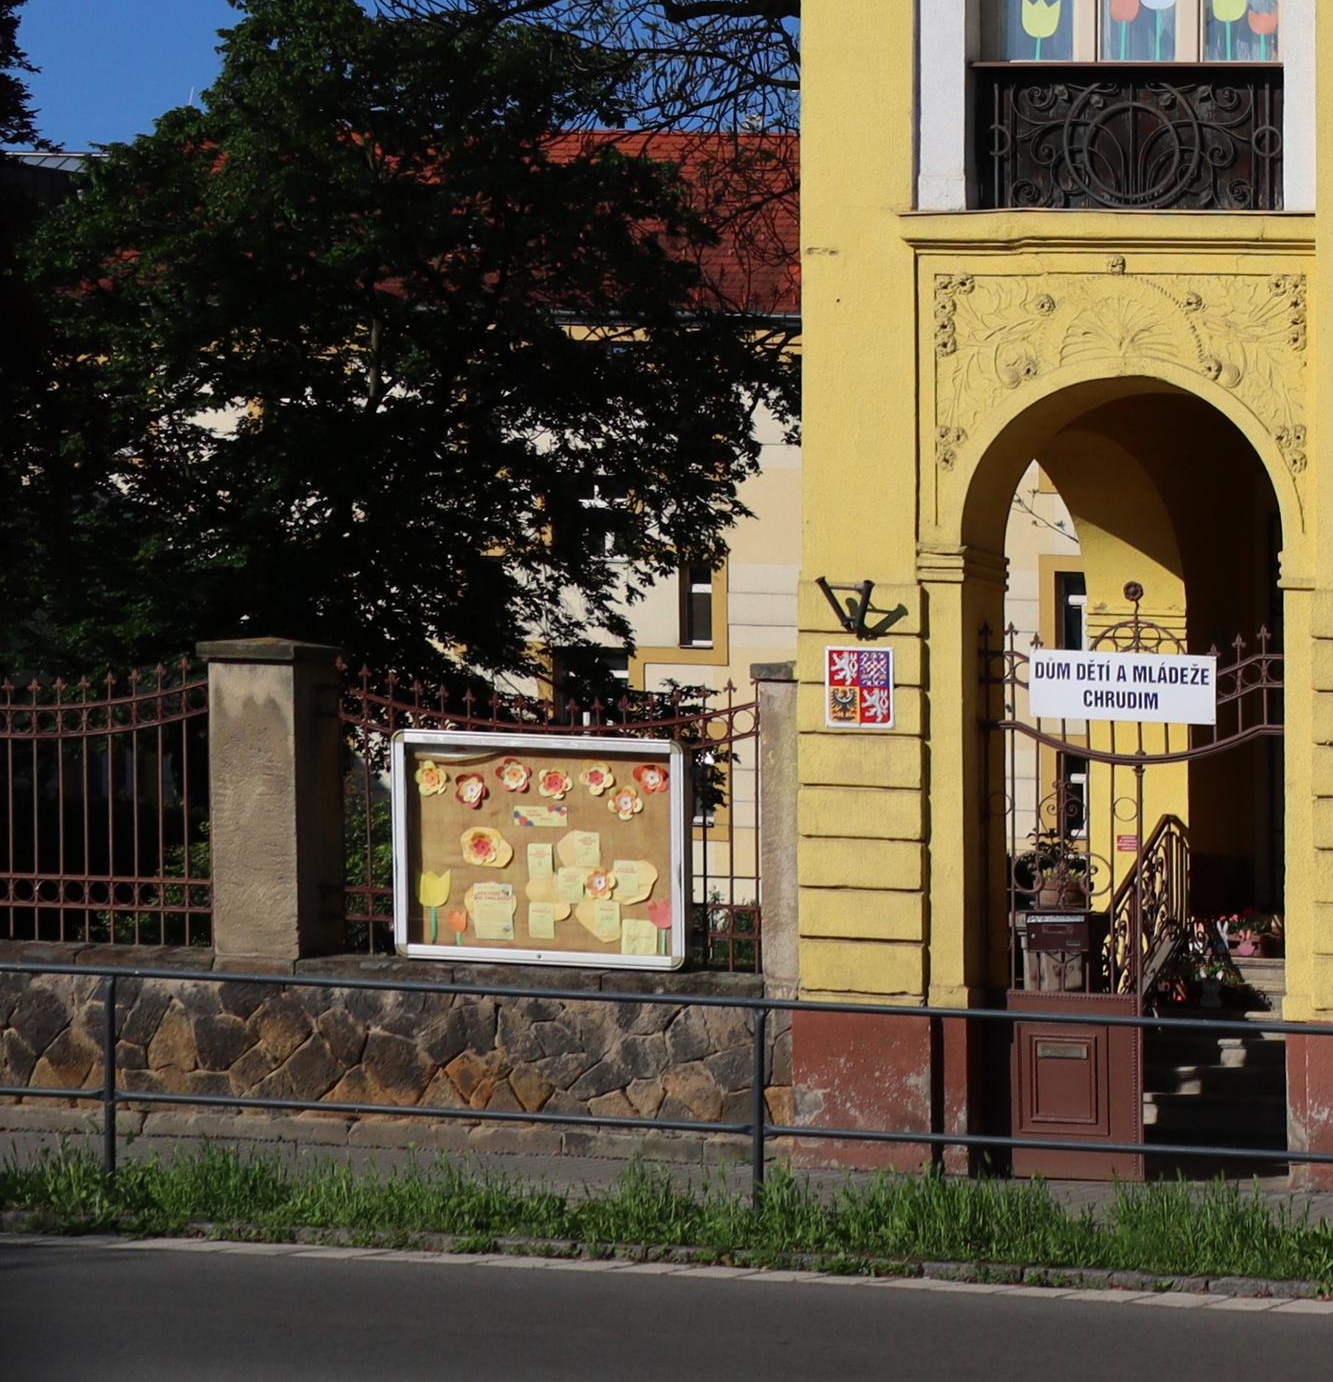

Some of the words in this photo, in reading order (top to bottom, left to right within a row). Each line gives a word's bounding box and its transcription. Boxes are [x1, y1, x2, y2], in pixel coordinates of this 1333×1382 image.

[1034, 657, 1071, 680] DŮM
[1076, 659, 1110, 682] DĚTÍ
[1116, 665, 1127, 682] A
[1132, 662, 1210, 686] MLÁDEŽE
[1083, 690, 1158, 710] CHRUDIM
